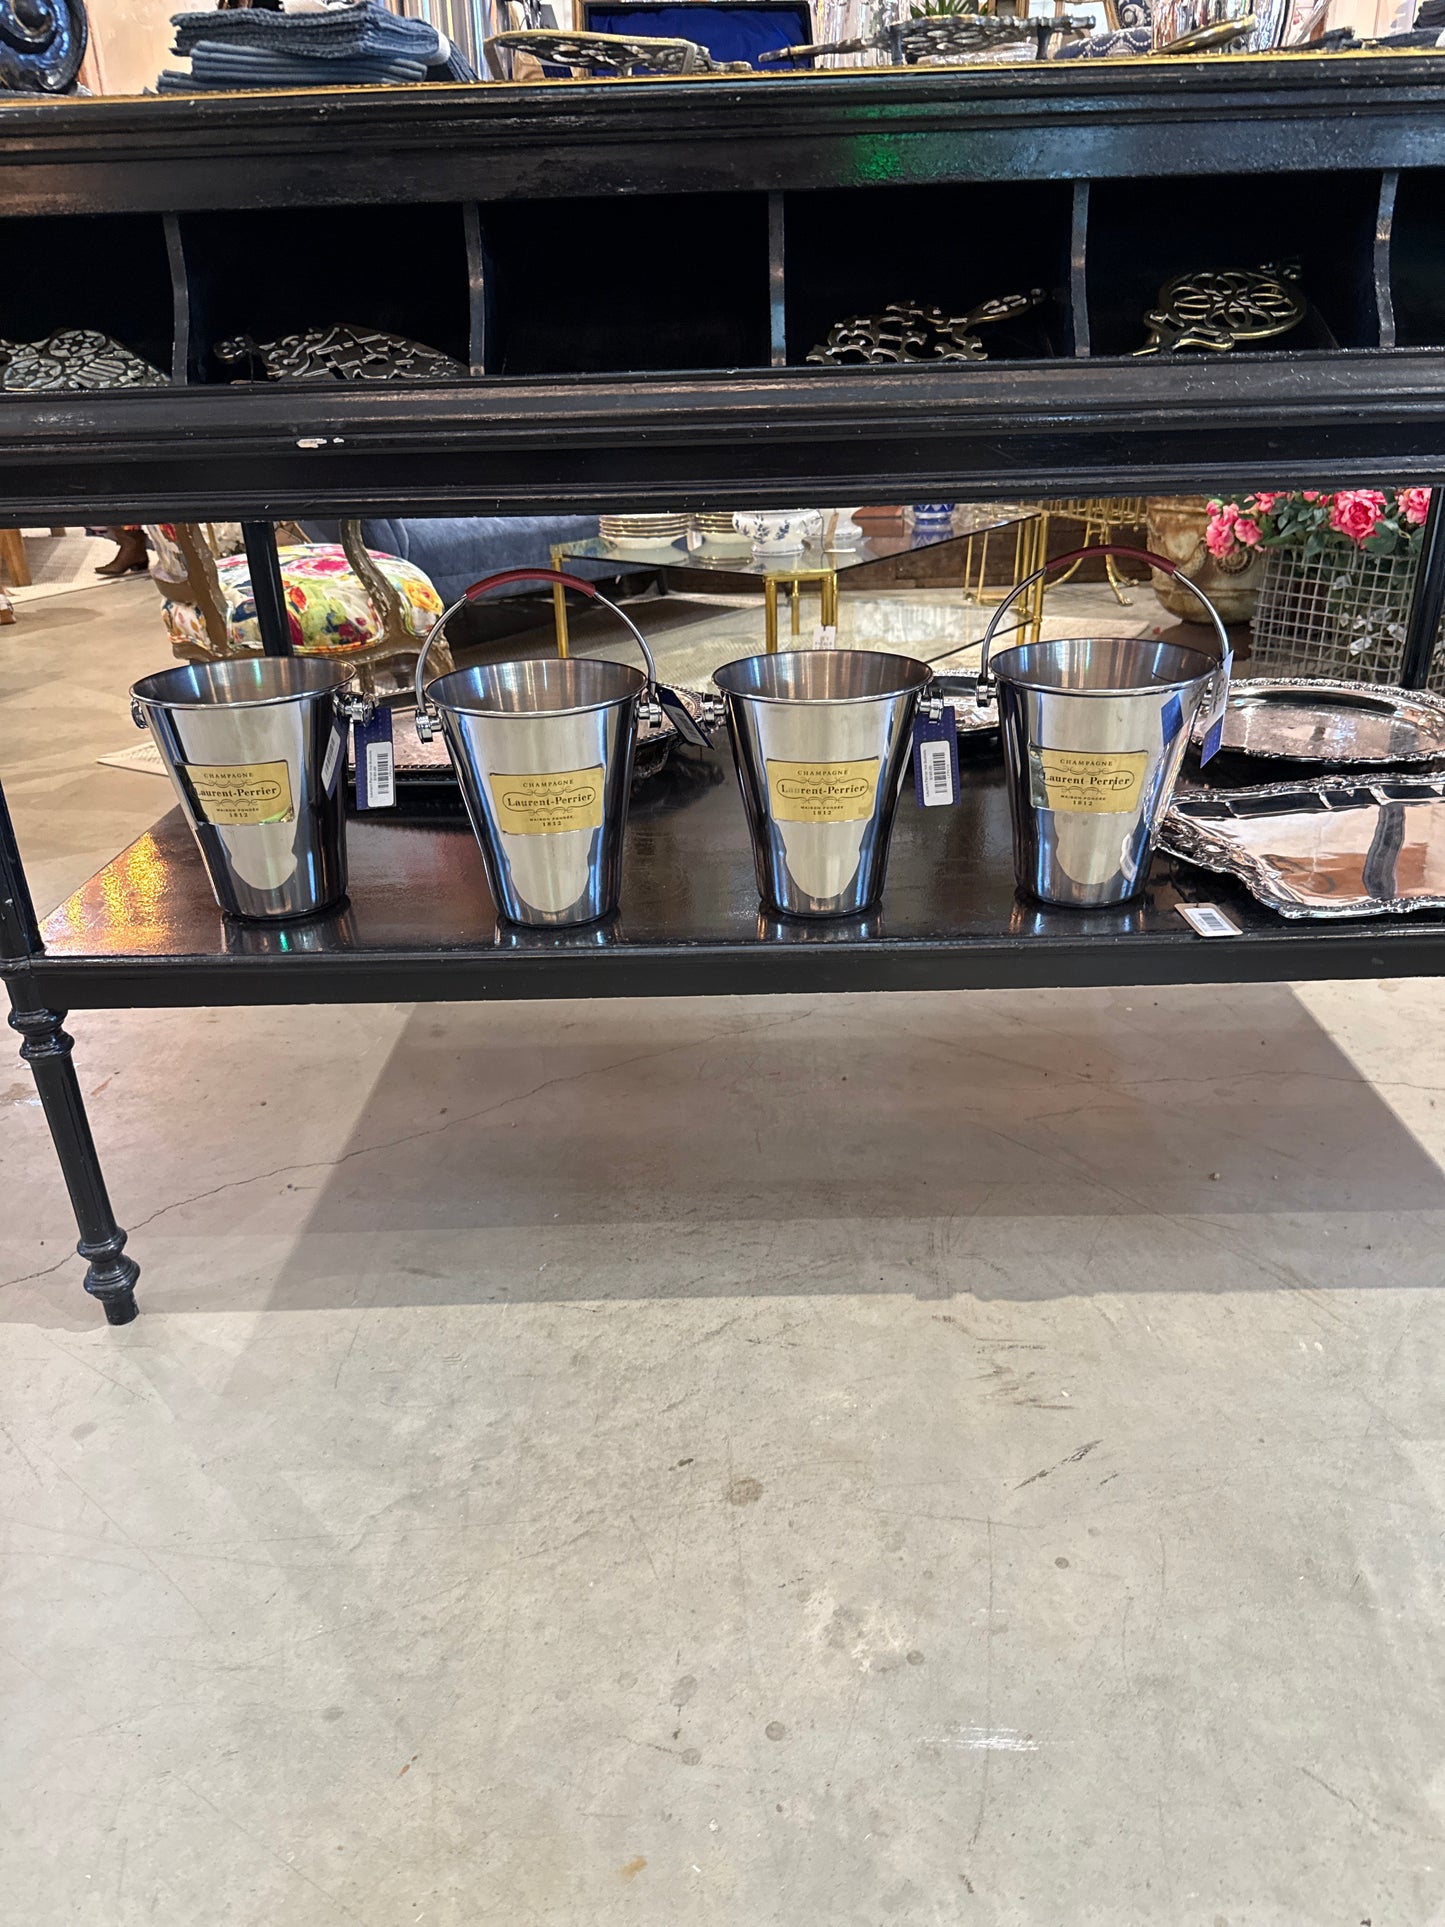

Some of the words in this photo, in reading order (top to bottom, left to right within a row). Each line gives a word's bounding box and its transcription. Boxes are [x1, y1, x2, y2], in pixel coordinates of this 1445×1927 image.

[1059, 758, 1113, 767] CHAMPAGNE
[522, 779, 574, 788] CHAMPAGNE
[781, 784, 865, 795] Laurent-Perrier
[507, 793, 592, 807] Laurent-Perrier
